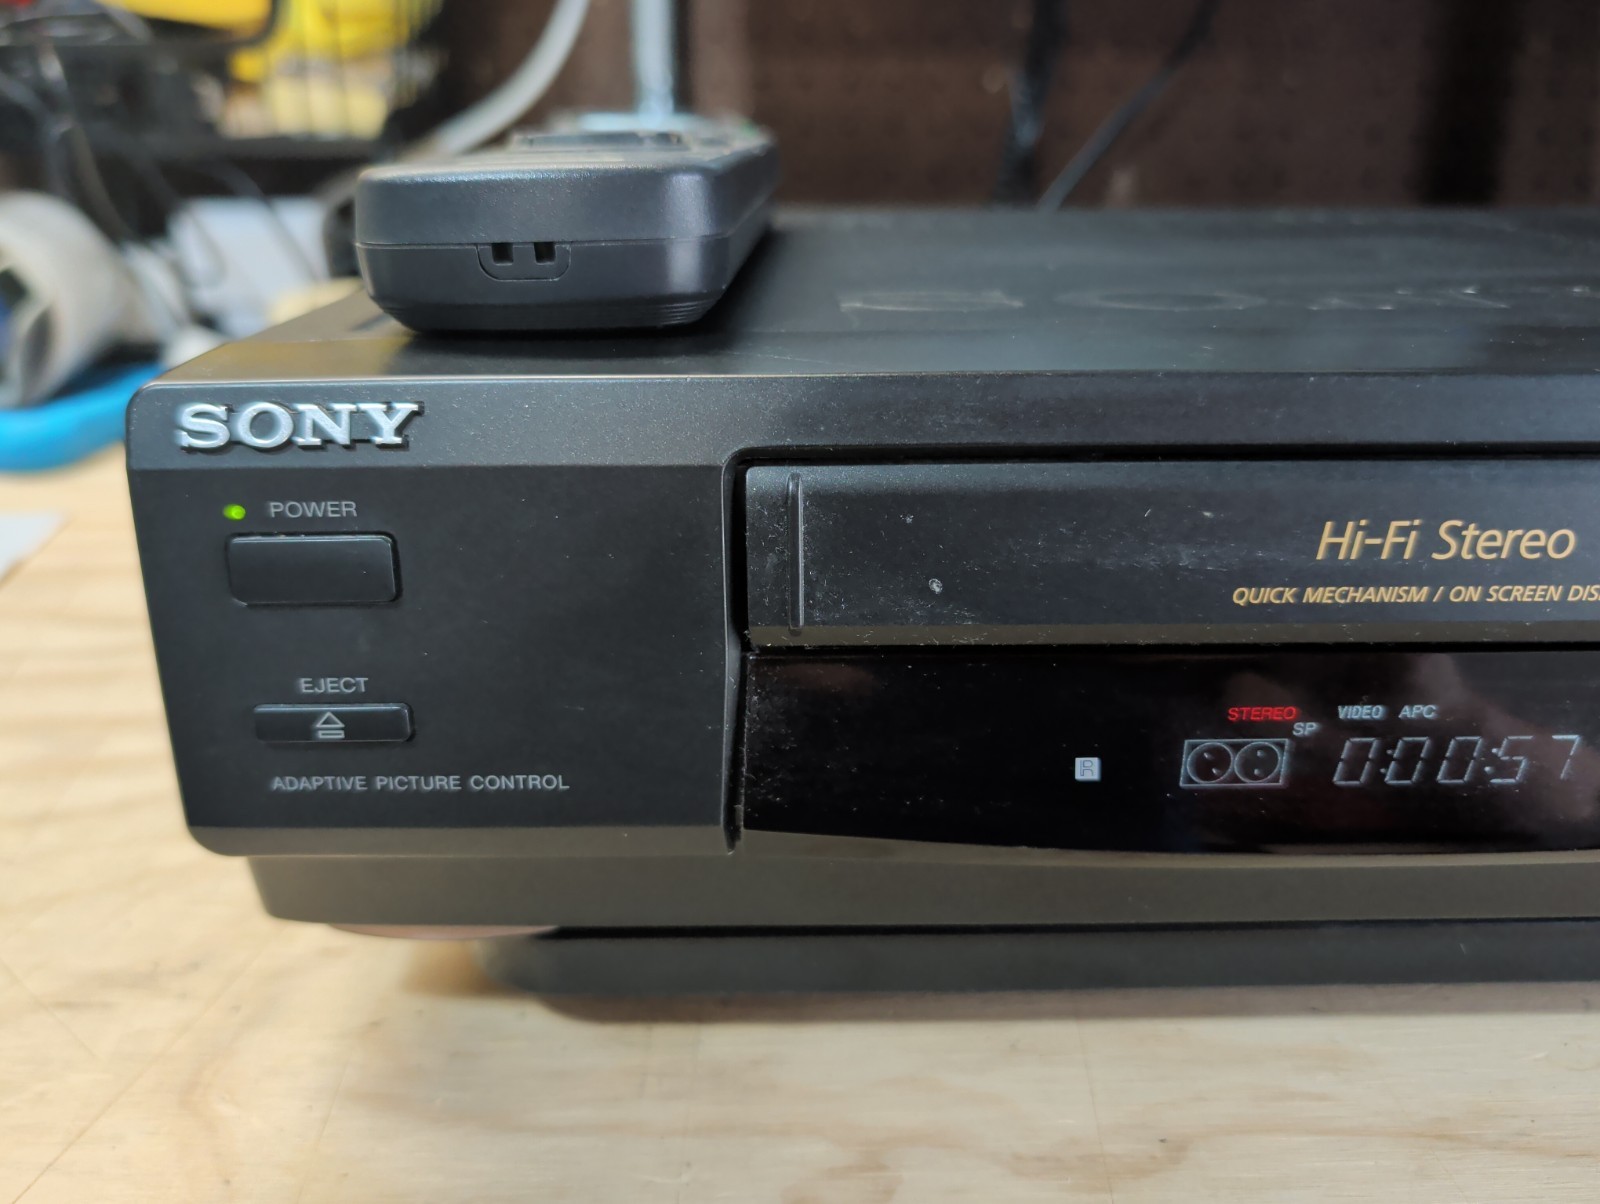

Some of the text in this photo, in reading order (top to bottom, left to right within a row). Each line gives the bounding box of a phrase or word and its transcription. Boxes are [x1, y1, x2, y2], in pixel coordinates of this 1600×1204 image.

[177, 401, 421, 450] SONY
[268, 501, 358, 519] POWER
[1315, 519, 1576, 561] Hi-Fi Stereo
[1232, 584, 1600, 606] QUICK MECHANISM / ON SCREEN DIS
[299, 677, 368, 694] EJECT
[1227, 706, 1299, 722] STEREO
[1338, 705, 1438, 720] VIDEO APC
[1293, 721, 1319, 737] SP
[271, 774, 569, 792] ADAPTIVE PICTURE CONTROL
